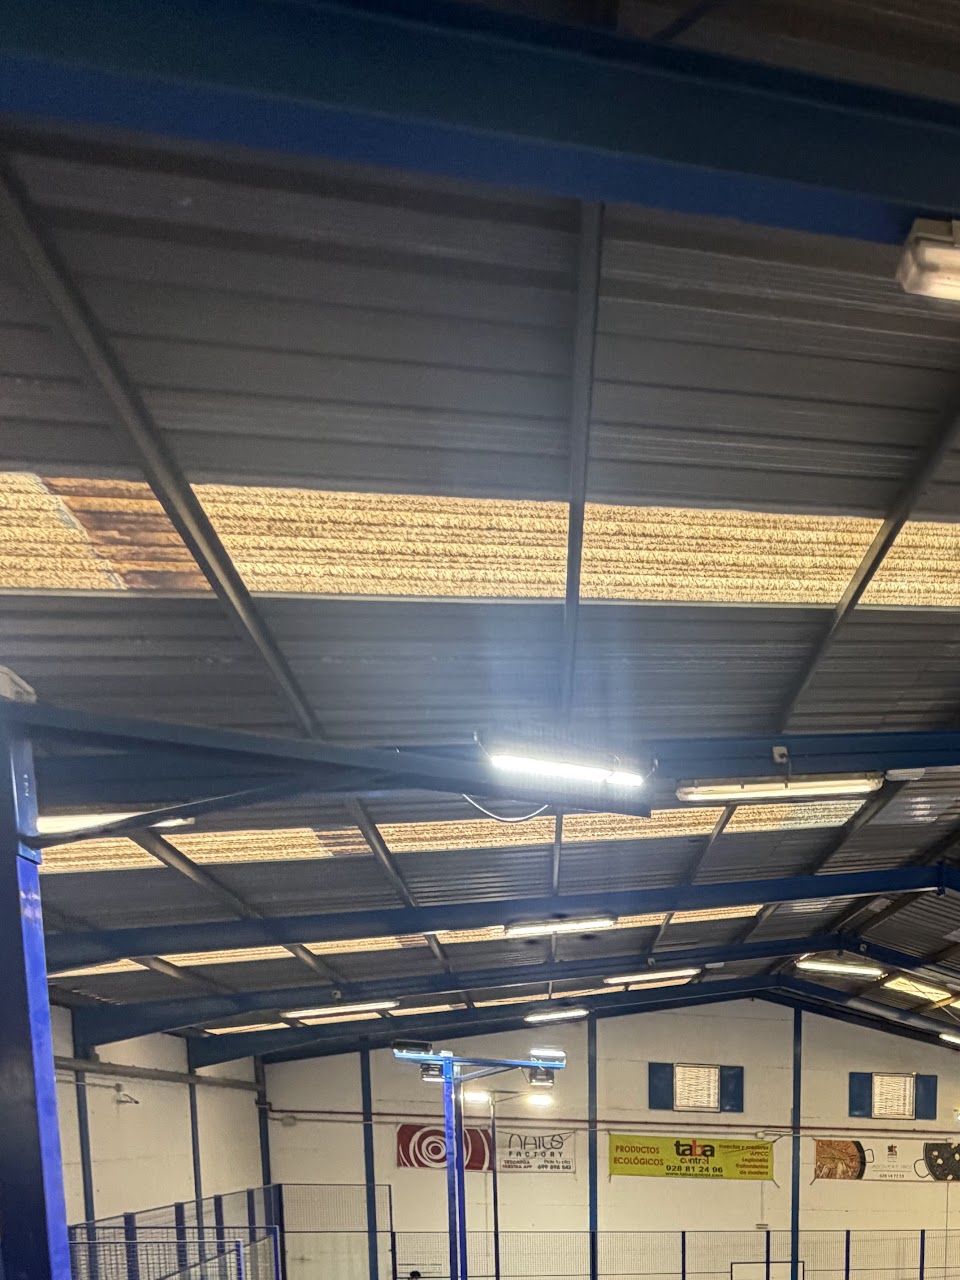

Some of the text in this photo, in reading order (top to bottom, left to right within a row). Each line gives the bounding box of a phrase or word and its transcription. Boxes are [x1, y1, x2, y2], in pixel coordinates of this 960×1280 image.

[508, 1133, 564, 1150] NAILS
[615, 1145, 660, 1154] PRODUCTOS
[674, 1138, 715, 1158] taba
[613, 1156, 664, 1166] ECOLÓGICOS
[680, 1156, 710, 1165] control
